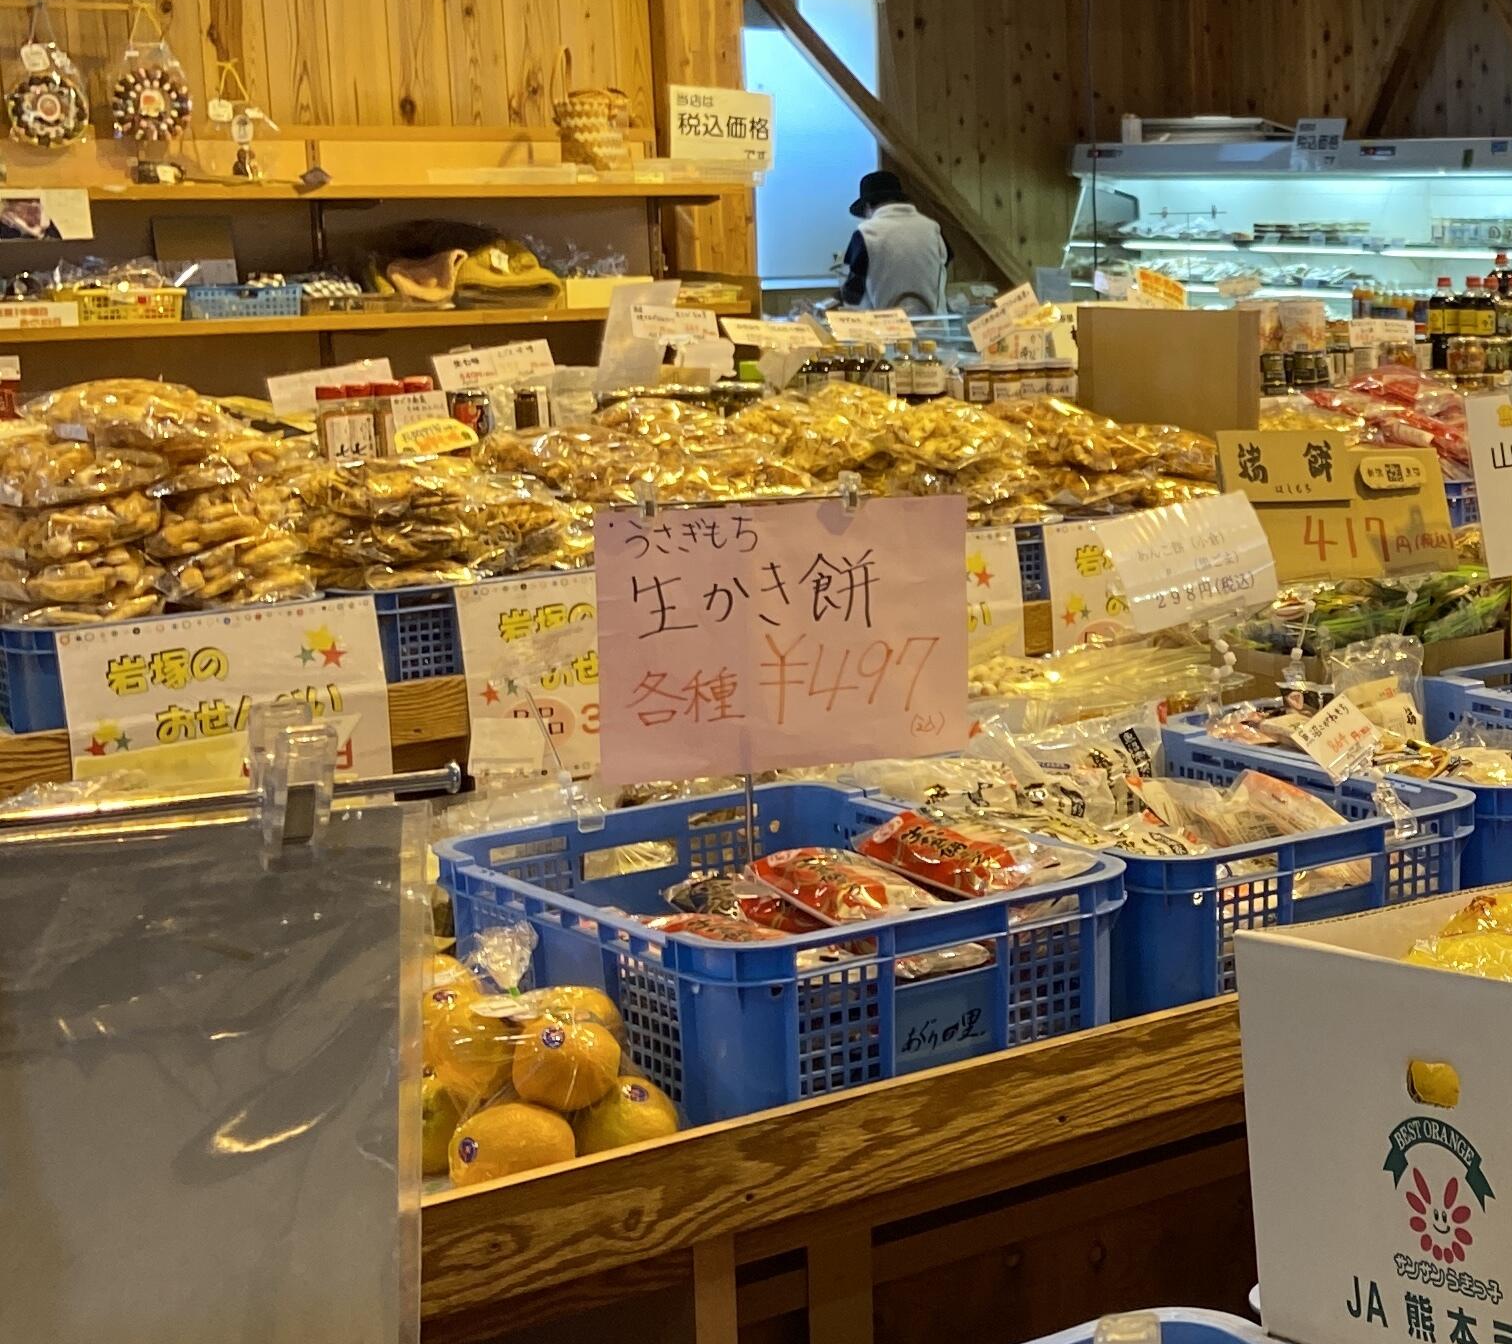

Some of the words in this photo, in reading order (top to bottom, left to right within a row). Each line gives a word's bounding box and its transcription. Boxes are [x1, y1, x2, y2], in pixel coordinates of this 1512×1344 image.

[677, 94, 713, 107] 当店は
[678, 113, 769, 140] 税込価格
[632, 549, 880, 639] 生かき餅
[106, 646, 229, 695] 岩塚の
[156, 684, 344, 744] おせんい
[1394, 1119, 1422, 1150] BEST
[1423, 1119, 1475, 1166] ORANGE
